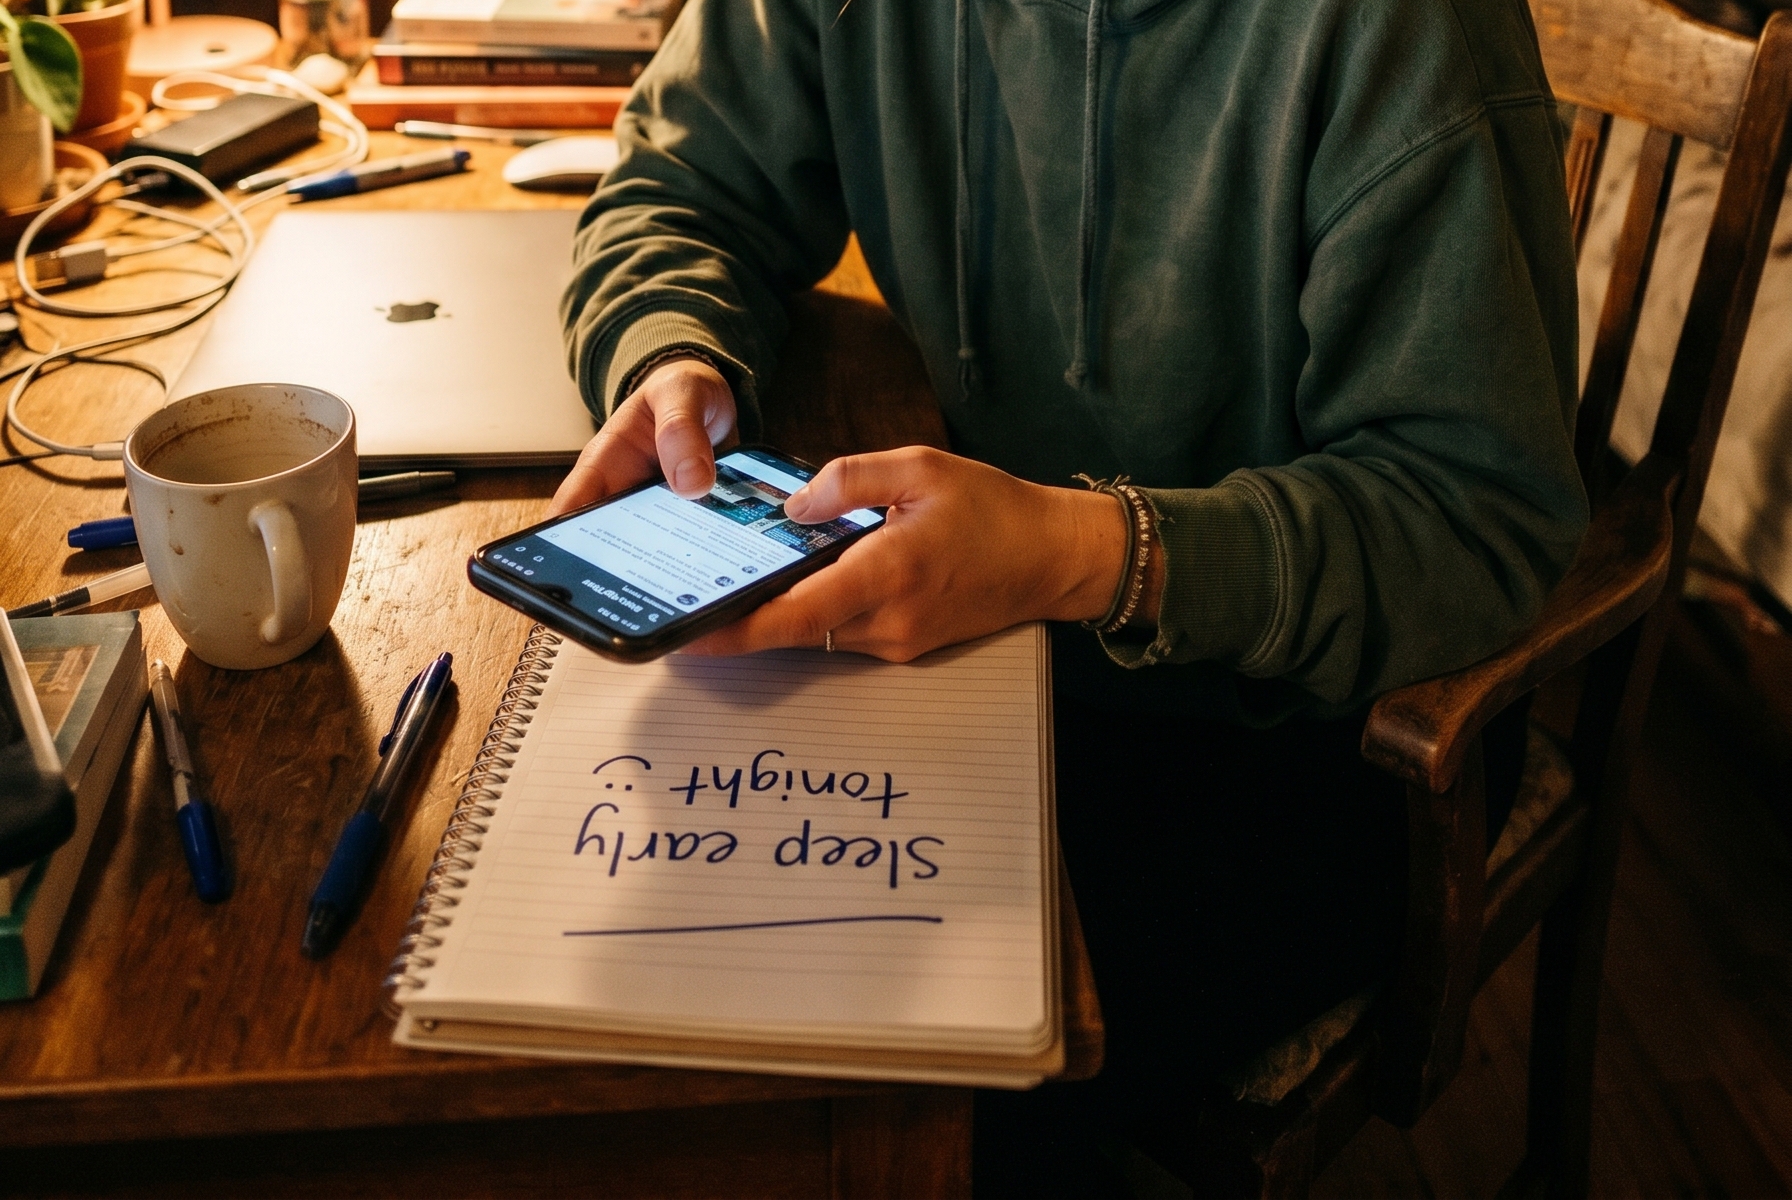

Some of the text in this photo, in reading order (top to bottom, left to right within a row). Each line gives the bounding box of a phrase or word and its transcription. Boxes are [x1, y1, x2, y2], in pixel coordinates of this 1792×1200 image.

[669, 749, 910, 820] tonight
[573, 802, 945, 890] Sleep early
